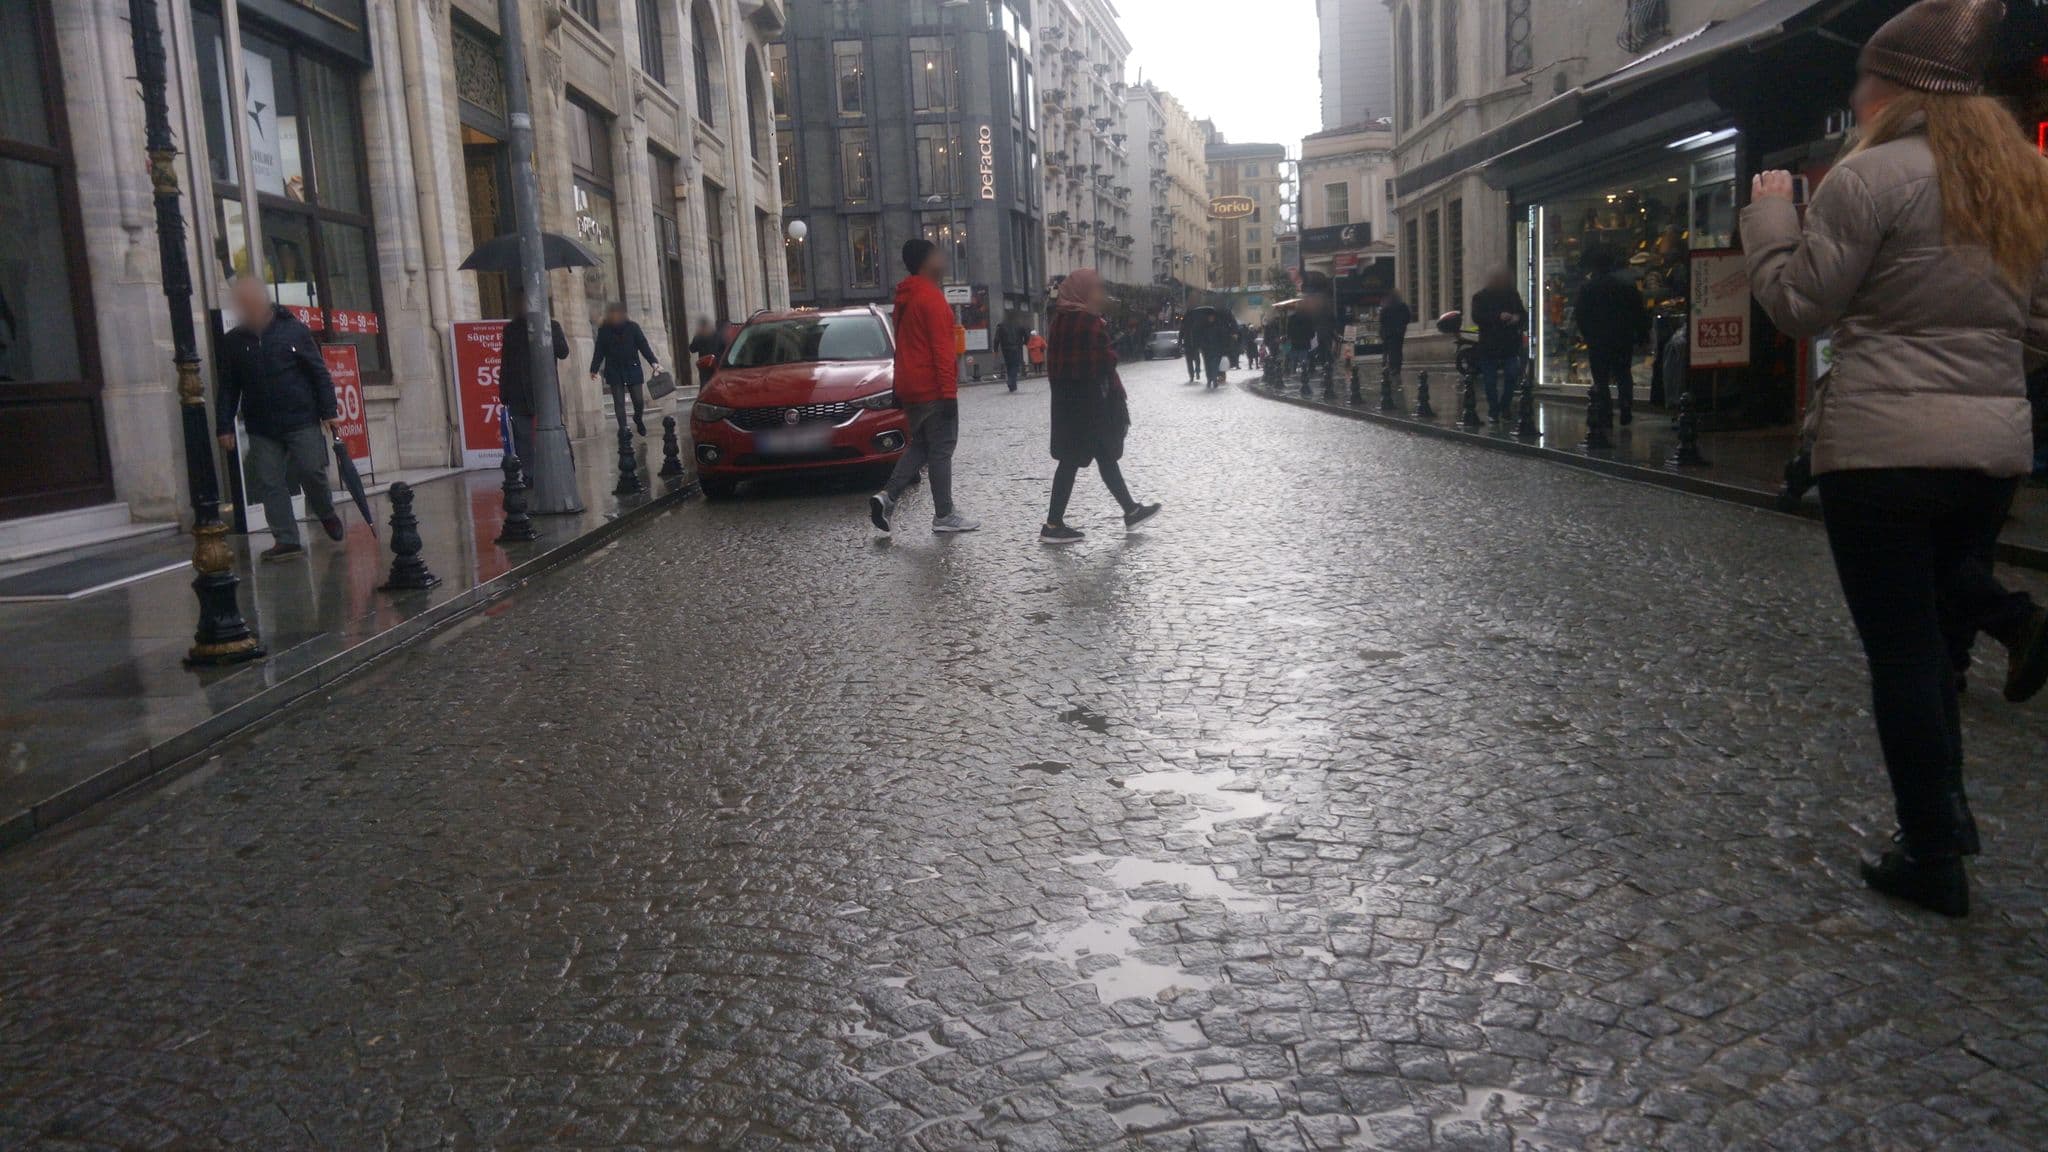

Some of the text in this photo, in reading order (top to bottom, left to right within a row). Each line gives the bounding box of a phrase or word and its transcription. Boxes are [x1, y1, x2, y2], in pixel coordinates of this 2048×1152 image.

[979, 125, 994, 199] DeFacto
[1211, 200, 1249, 212] Torku
[299, 309, 367, 328] 50 50 50
[467, 333, 495, 342] Süper
[1700, 322, 1738, 337] %10
[334, 384, 360, 420] 50
